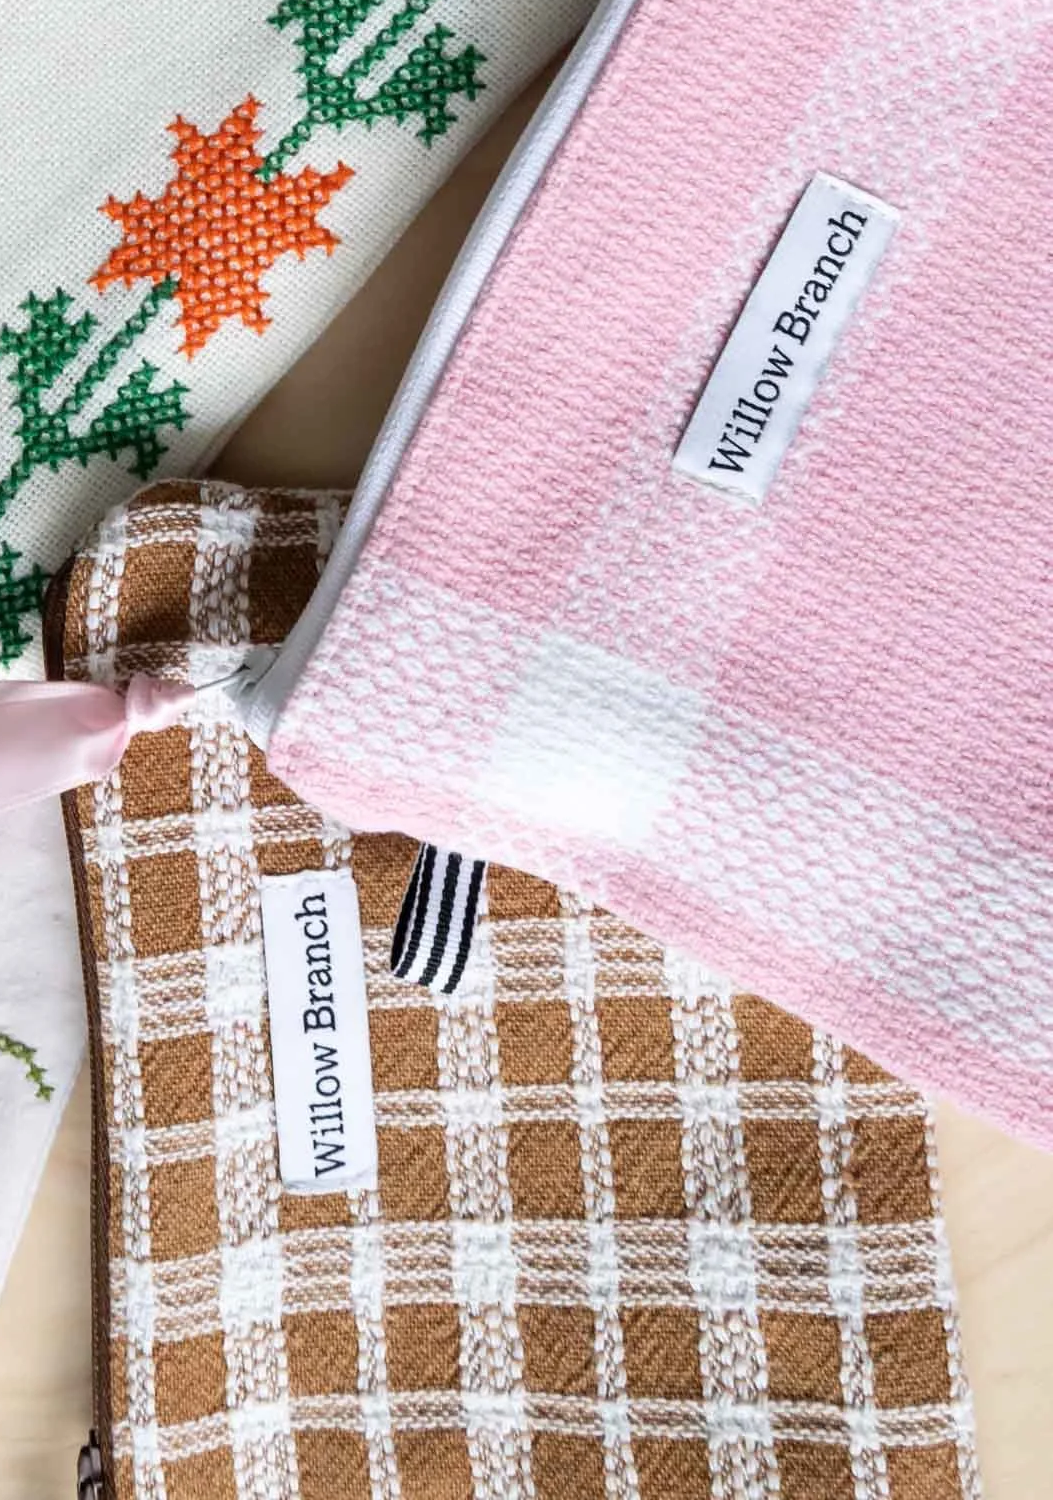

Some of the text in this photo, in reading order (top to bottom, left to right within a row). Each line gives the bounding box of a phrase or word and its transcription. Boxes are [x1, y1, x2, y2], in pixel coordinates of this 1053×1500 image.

[708, 211, 867, 472] Willow Branch
[294, 892, 345, 1178] Willow Branch
